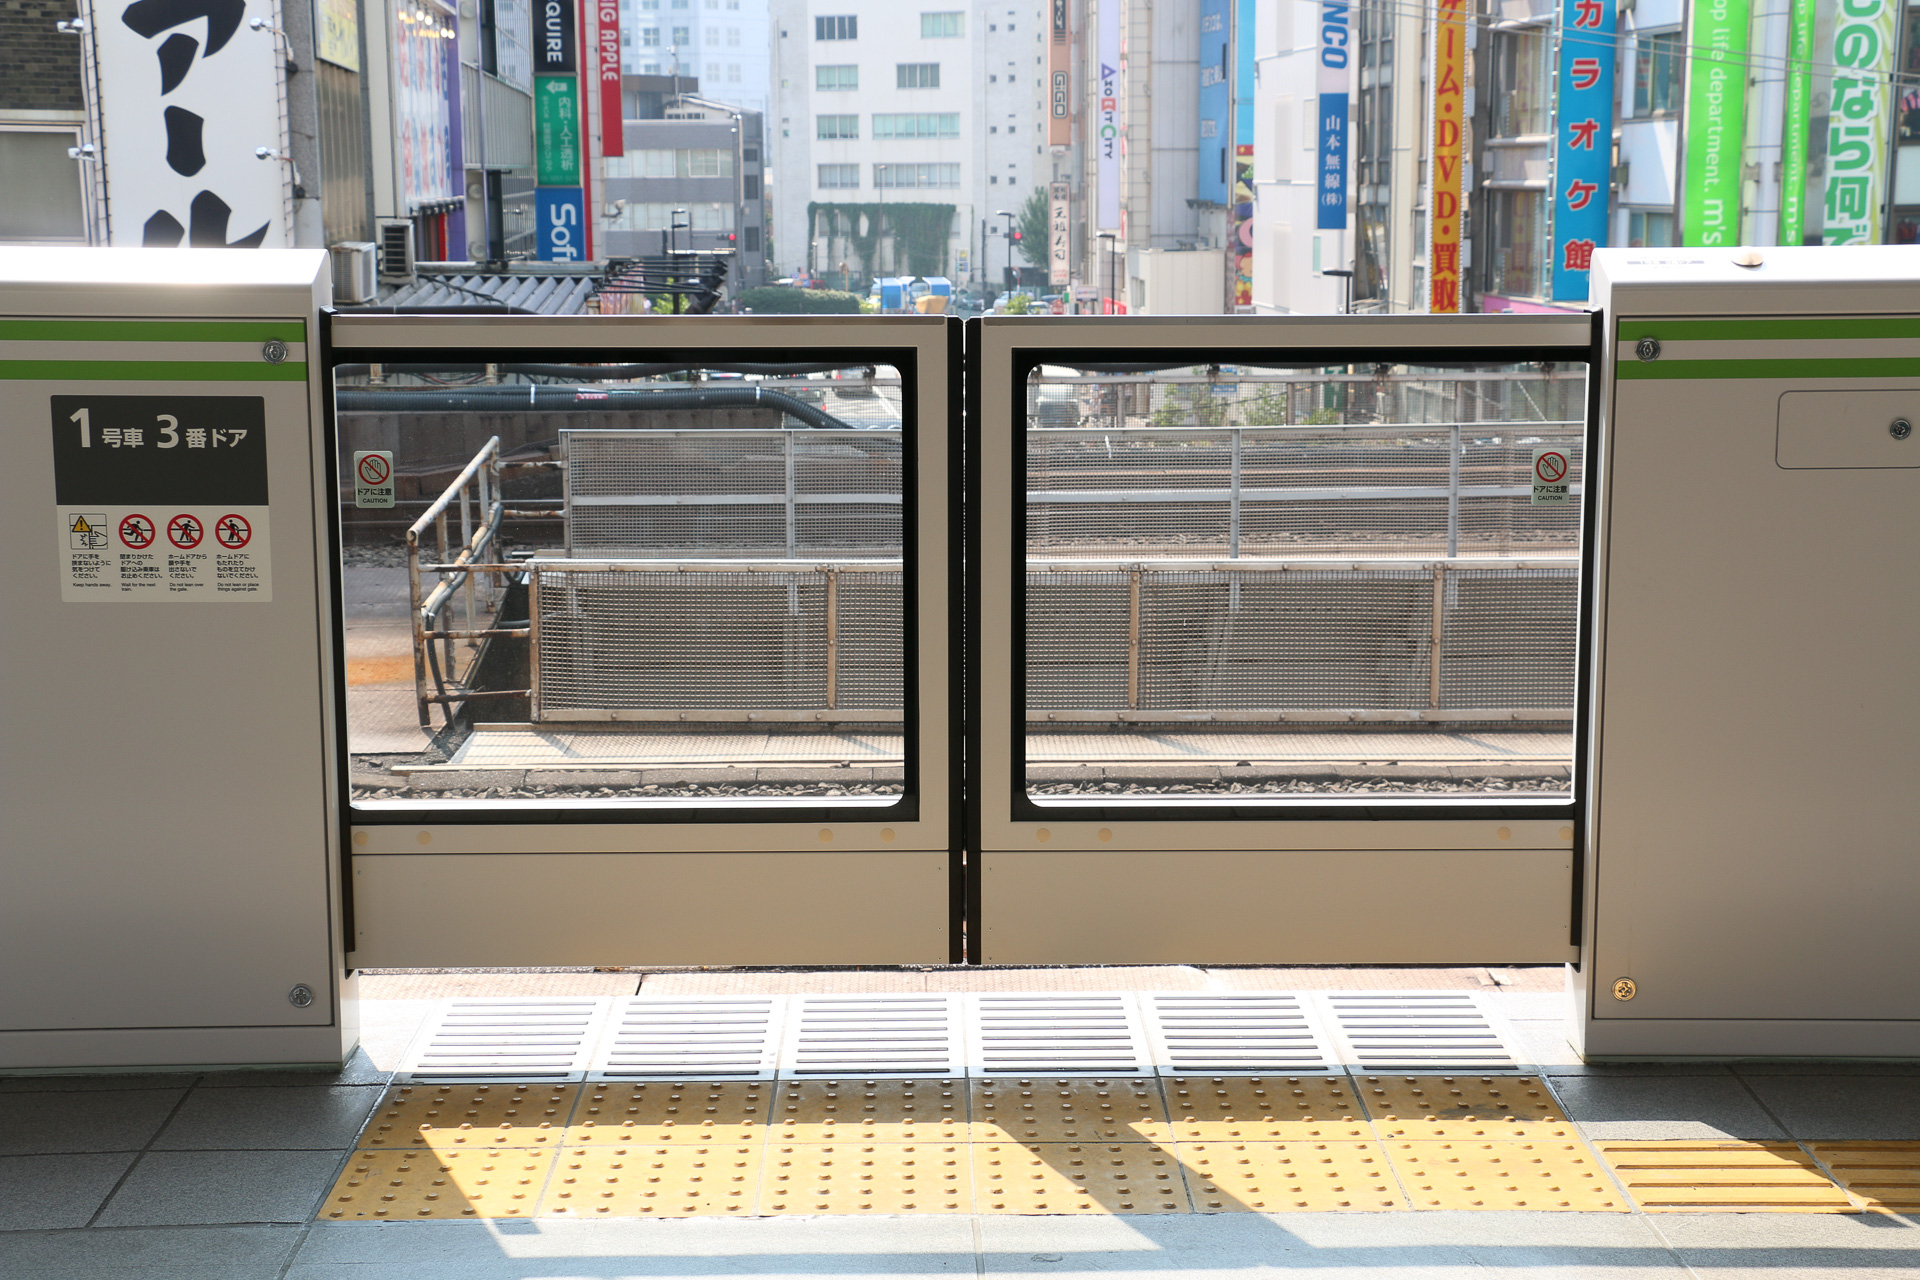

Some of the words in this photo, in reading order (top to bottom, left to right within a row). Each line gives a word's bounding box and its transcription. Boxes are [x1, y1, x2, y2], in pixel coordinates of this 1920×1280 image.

[600, 0, 617, 23] IG
[545, 0, 562, 62] QUIRE
[1711, 28, 1730, 62] life
[601, 30, 618, 80] APPLE
[1704, 67, 1728, 193] department.
[357, 487, 392, 495] ドアに注意
[1533, 485, 1567, 493] ドアに注意
